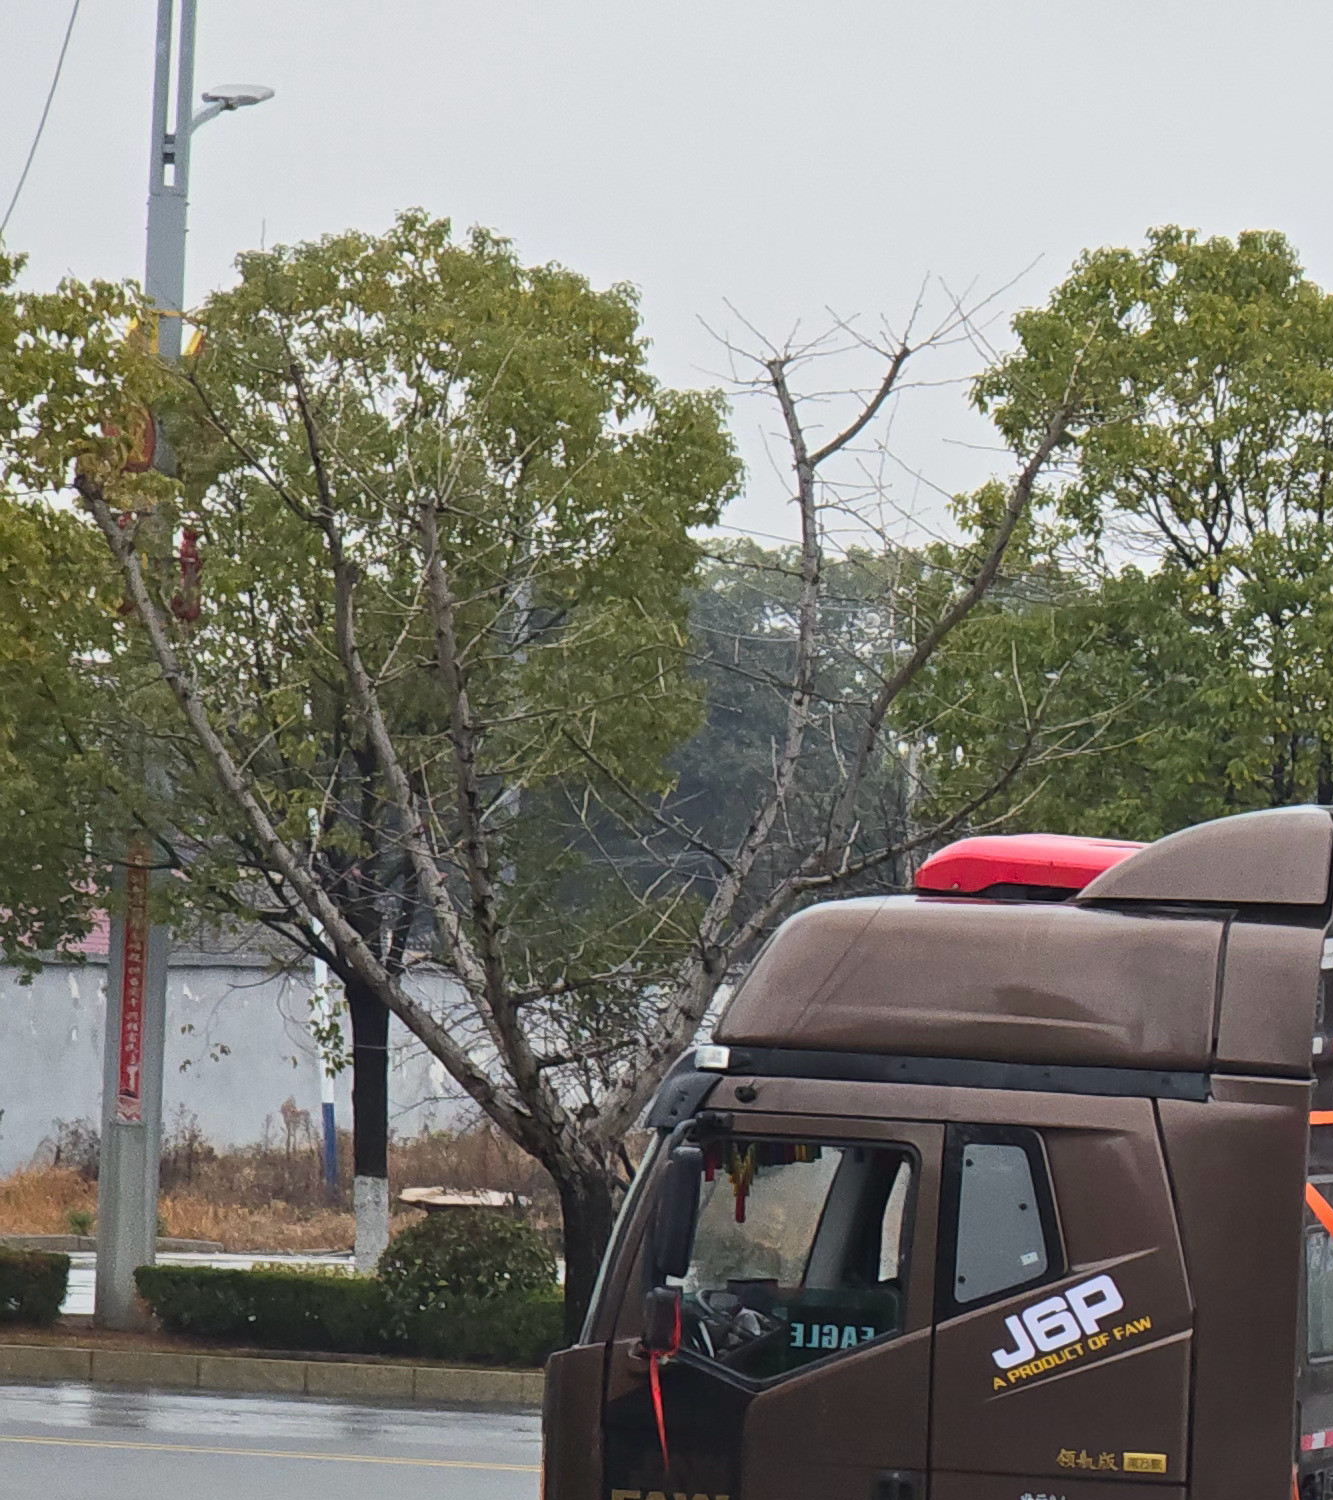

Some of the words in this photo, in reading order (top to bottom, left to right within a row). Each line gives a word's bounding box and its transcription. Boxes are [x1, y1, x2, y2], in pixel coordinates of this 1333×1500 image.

[992, 1274, 1124, 1369] J6P
[993, 1377, 1007, 1390] A
[1007, 1343, 1083, 1383] PRODUCT
[1087, 1332, 1110, 1350] OF
[1112, 1316, 1152, 1340] FAW
